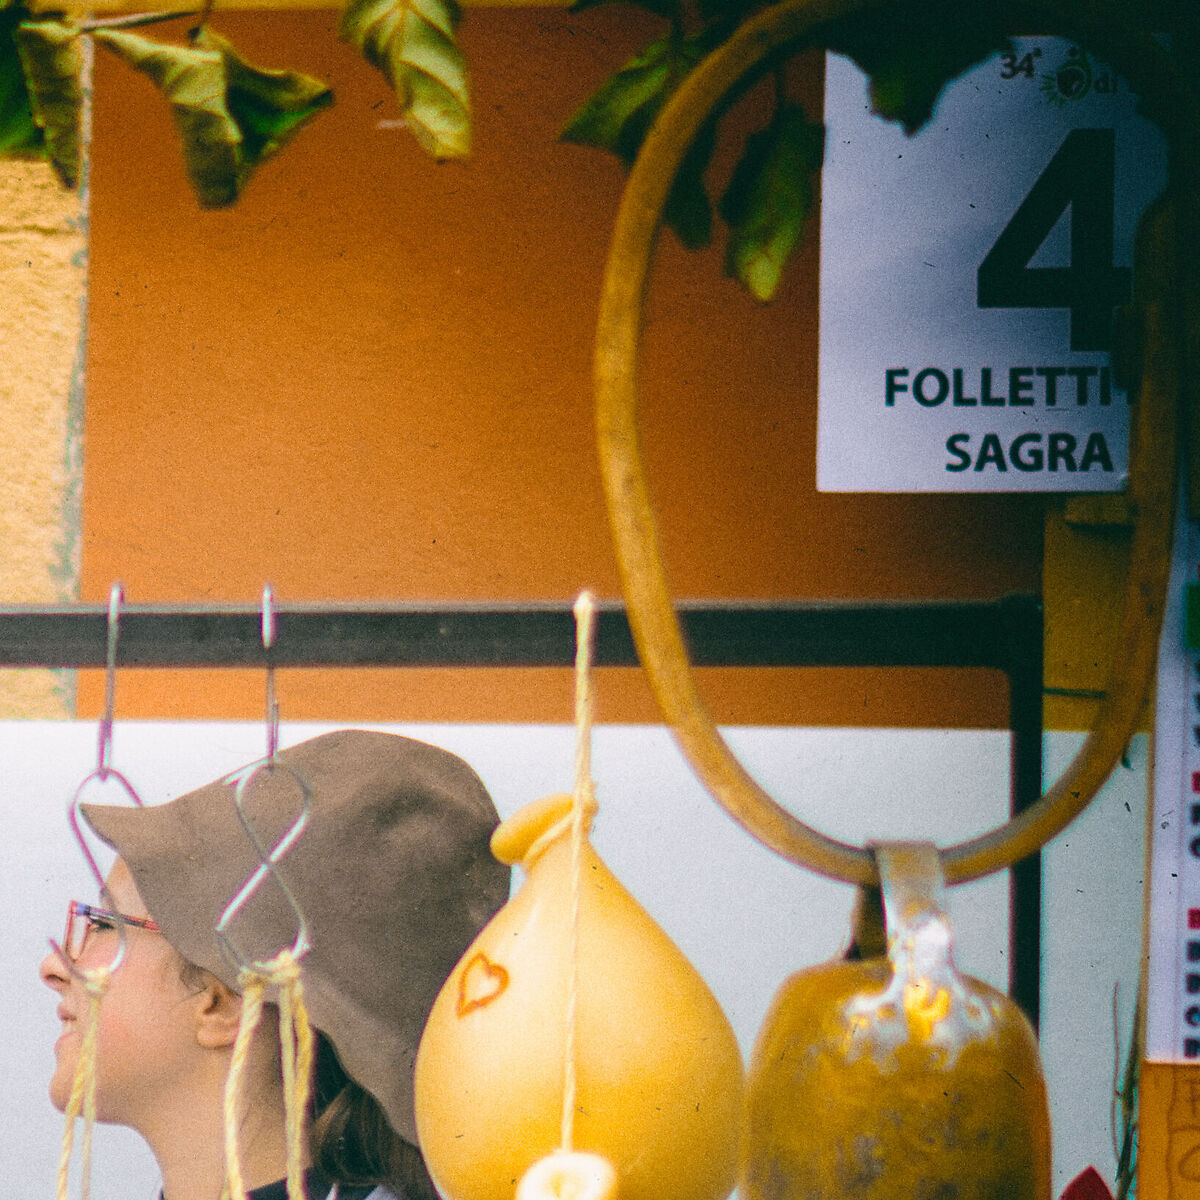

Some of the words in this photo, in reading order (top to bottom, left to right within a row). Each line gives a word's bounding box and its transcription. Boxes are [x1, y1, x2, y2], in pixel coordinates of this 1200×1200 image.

[976, 128, 1133, 353] 4
[884, 366, 1111, 408] FOLLETTI
[944, 432, 1114, 474] SAGRA
